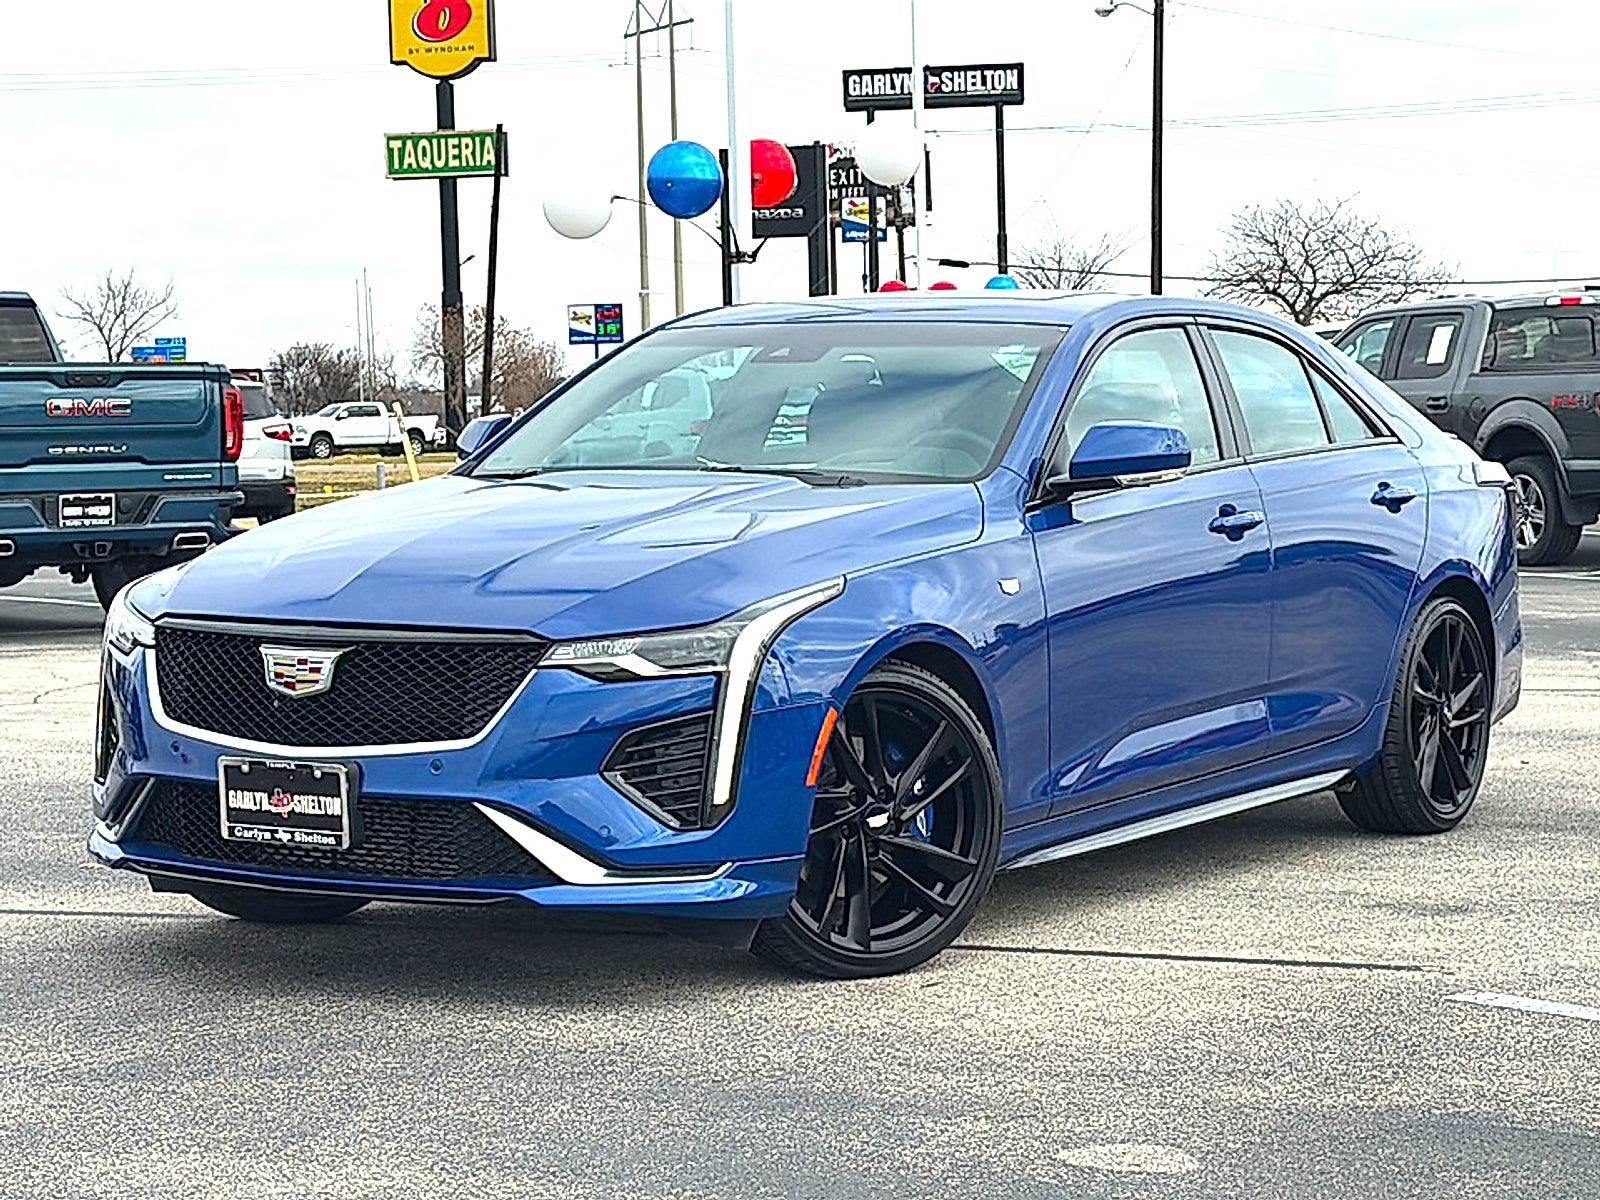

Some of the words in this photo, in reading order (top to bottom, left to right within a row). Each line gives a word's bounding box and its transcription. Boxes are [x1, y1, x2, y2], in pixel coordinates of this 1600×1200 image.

[408, 47, 420, 55] BY
[424, 45, 475, 54] WYNDHAM
[940, 68, 1019, 94] SHELTON
[388, 136, 496, 171] TAQUERIA
[829, 167, 864, 187] EXIT
[46, 398, 132, 417] GMC
[48, 444, 127, 455] DENALI
[292, 794, 342, 816] SHELTON
[293, 831, 337, 845] Shelton
